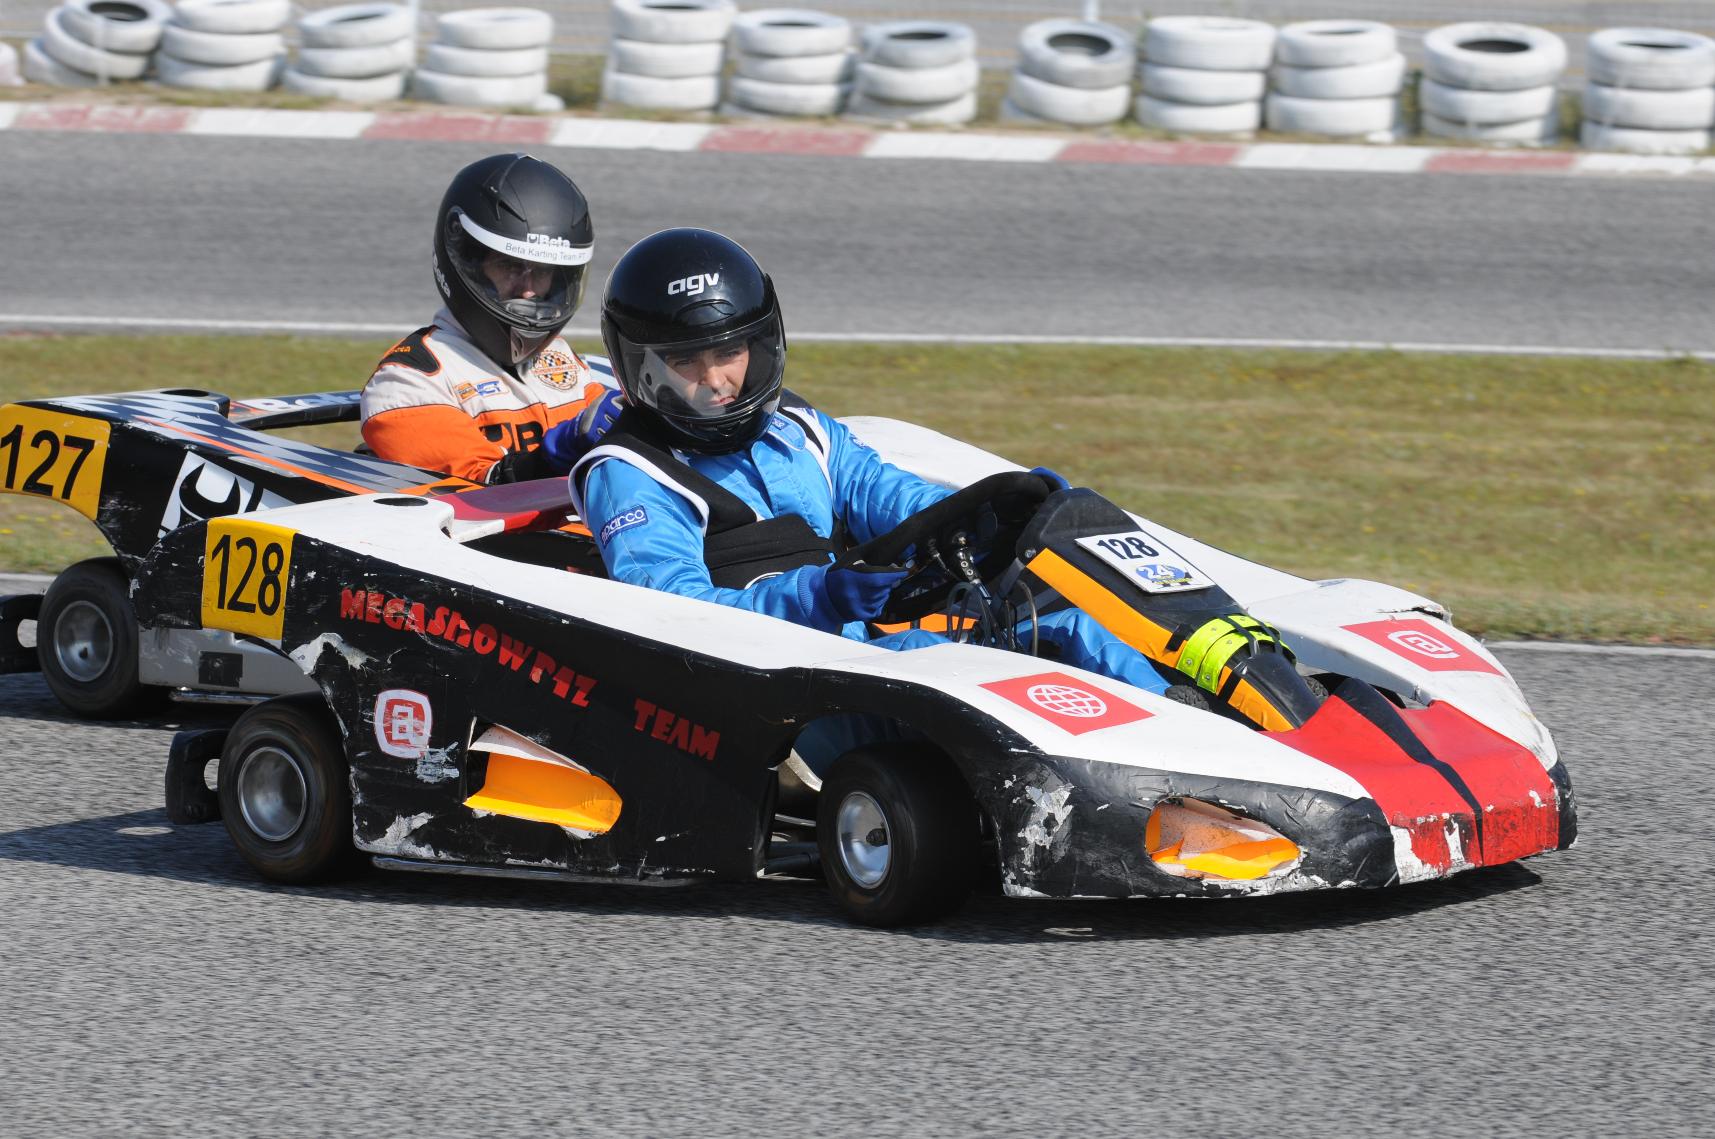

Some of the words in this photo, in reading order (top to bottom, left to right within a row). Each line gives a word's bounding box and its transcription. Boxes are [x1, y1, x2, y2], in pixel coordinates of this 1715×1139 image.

[505, 243, 526, 256] Beta
[528, 247, 558, 260] Karting
[560, 251, 577, 262] Team
[667, 272, 720, 296] agv
[0, 424, 96, 500] 127
[1096, 536, 1160, 560] 128
[211, 533, 285, 617] 128
[632, 698, 721, 762] TEAM
